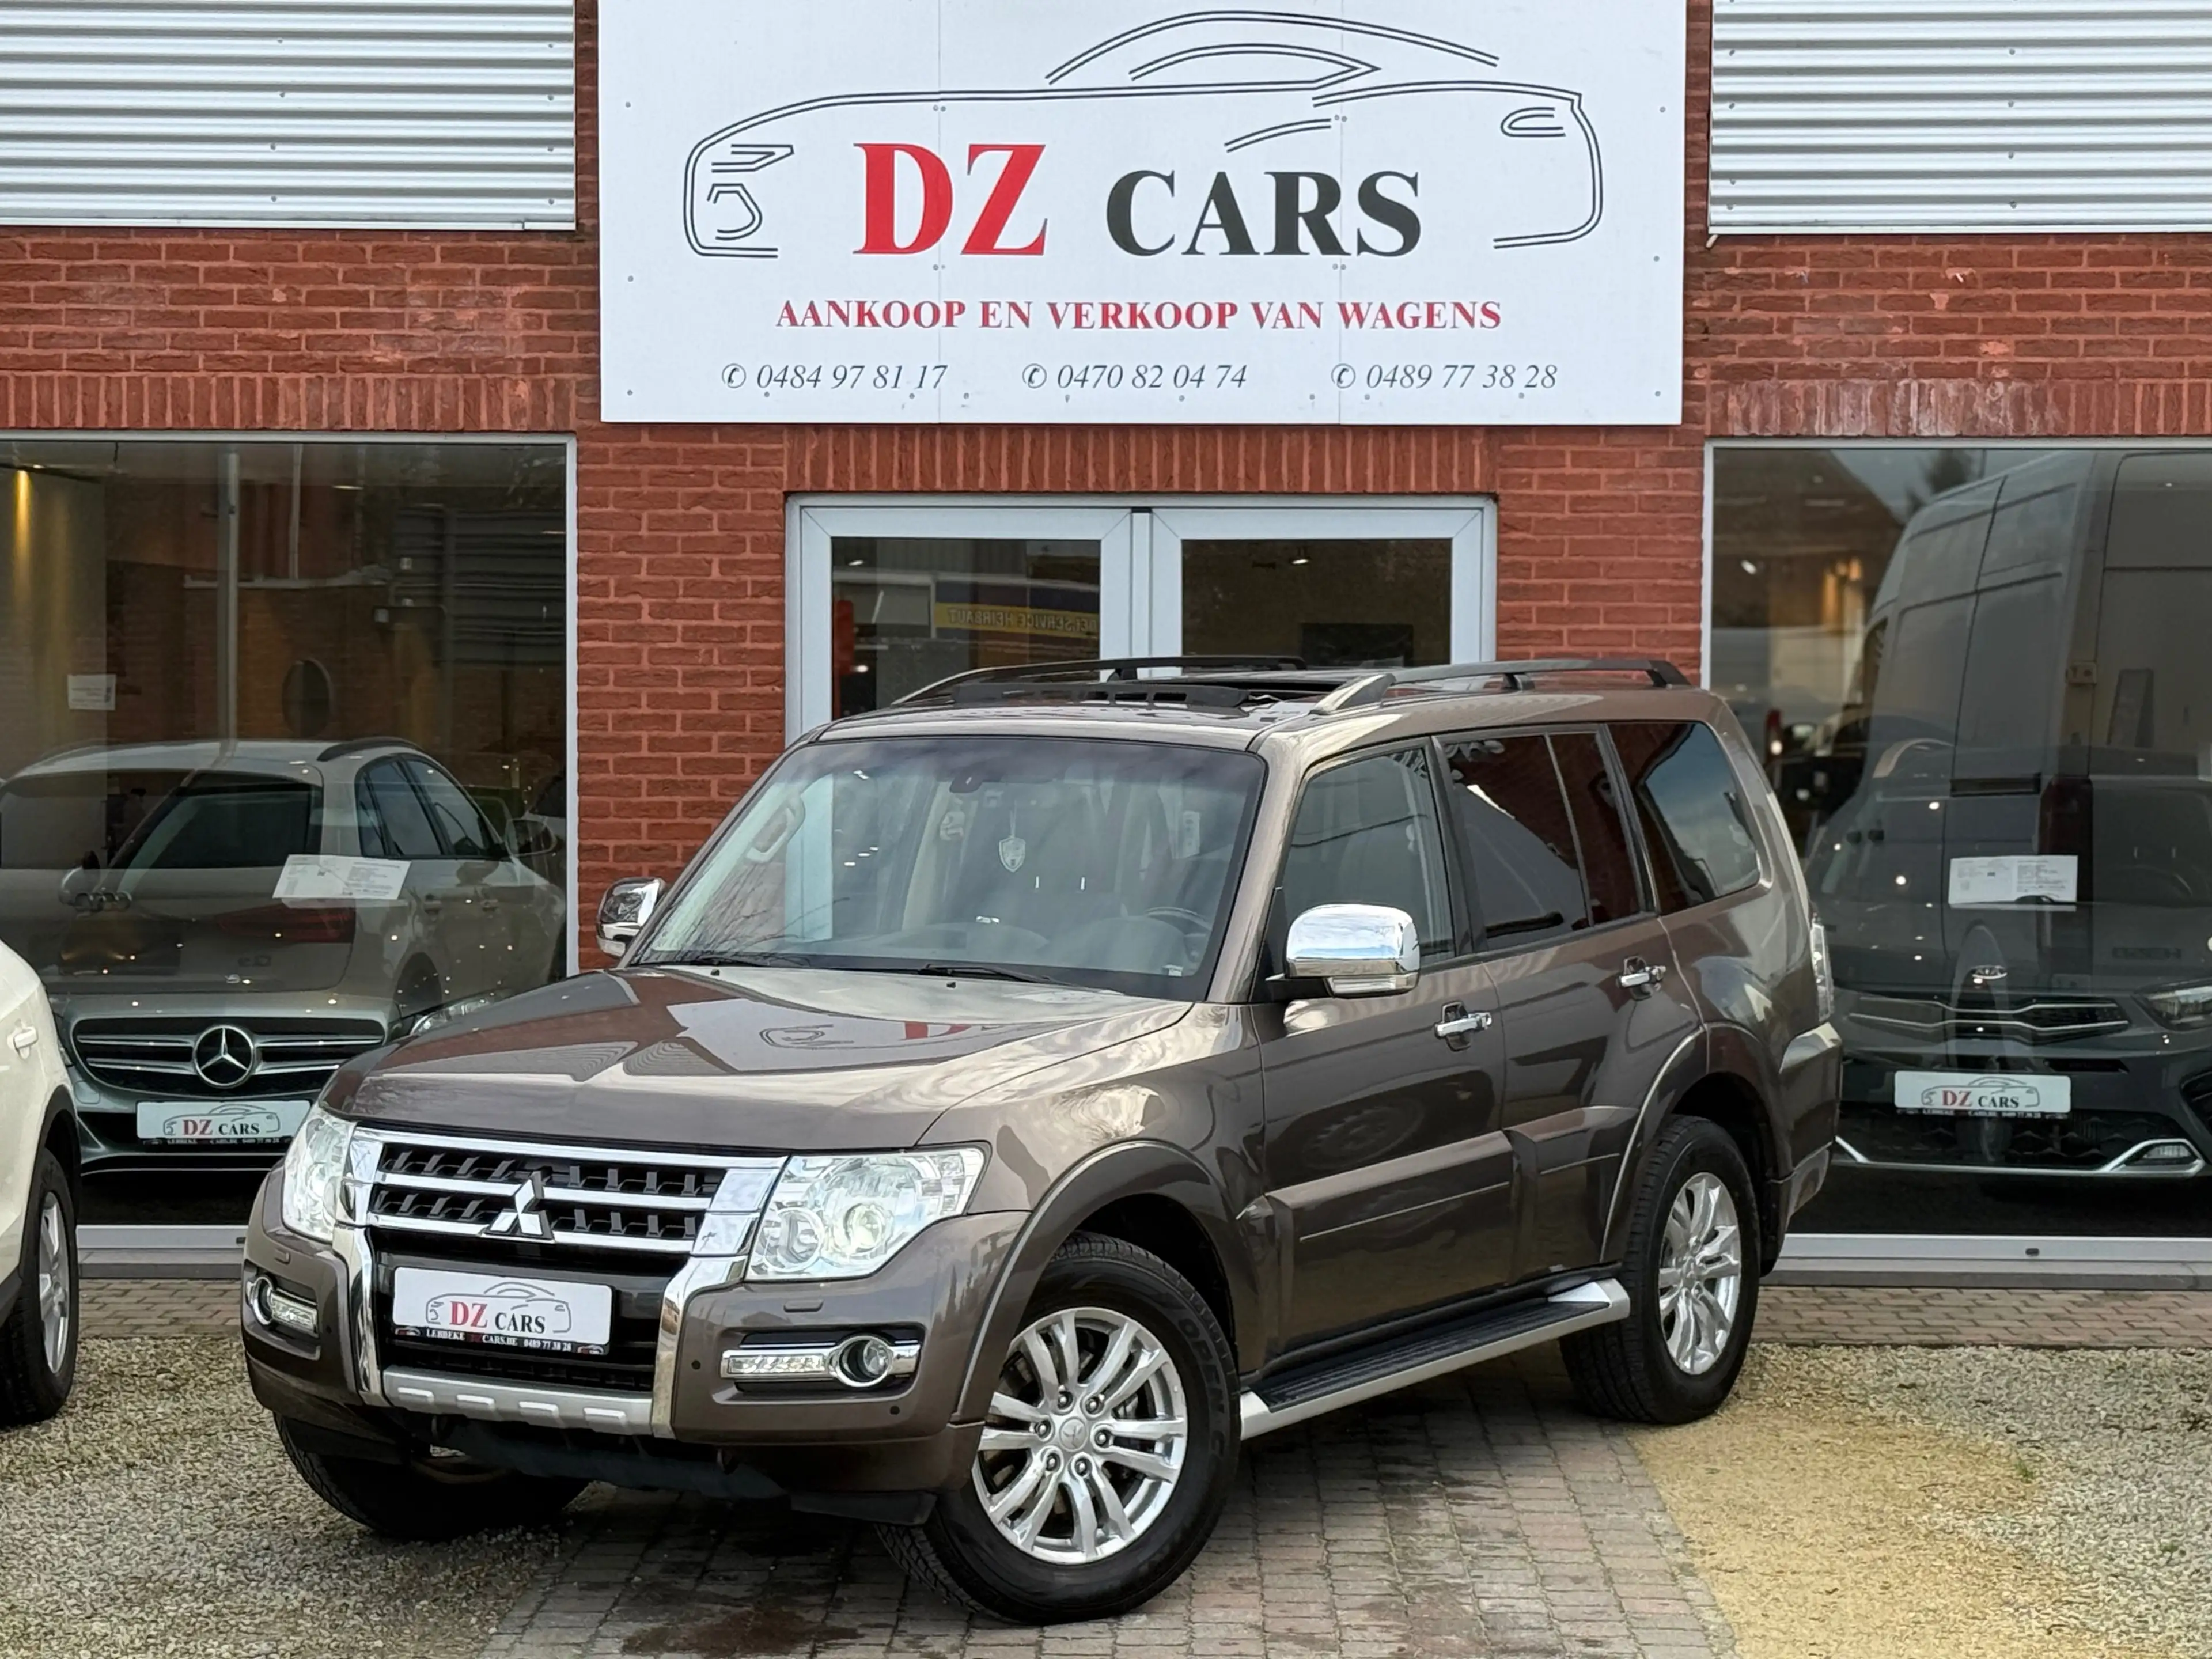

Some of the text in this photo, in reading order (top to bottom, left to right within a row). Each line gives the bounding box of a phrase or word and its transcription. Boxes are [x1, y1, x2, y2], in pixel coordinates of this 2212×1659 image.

[853, 143, 1421, 257] DZ CARS
[776, 301, 1501, 329] AANKOOP EN VERKOOP VAN WAGENS
[757, 364, 948, 389] 0484 97 81 17
[1057, 364, 1247, 389] 0470 82 04 74
[1366, 364, 1558, 388] 0489 77 38 28
[1942, 1090, 2020, 1108] DZ CARS
[182, 1119, 260, 1136] DZ CARS
[449, 1300, 546, 1334] DZ CARS
